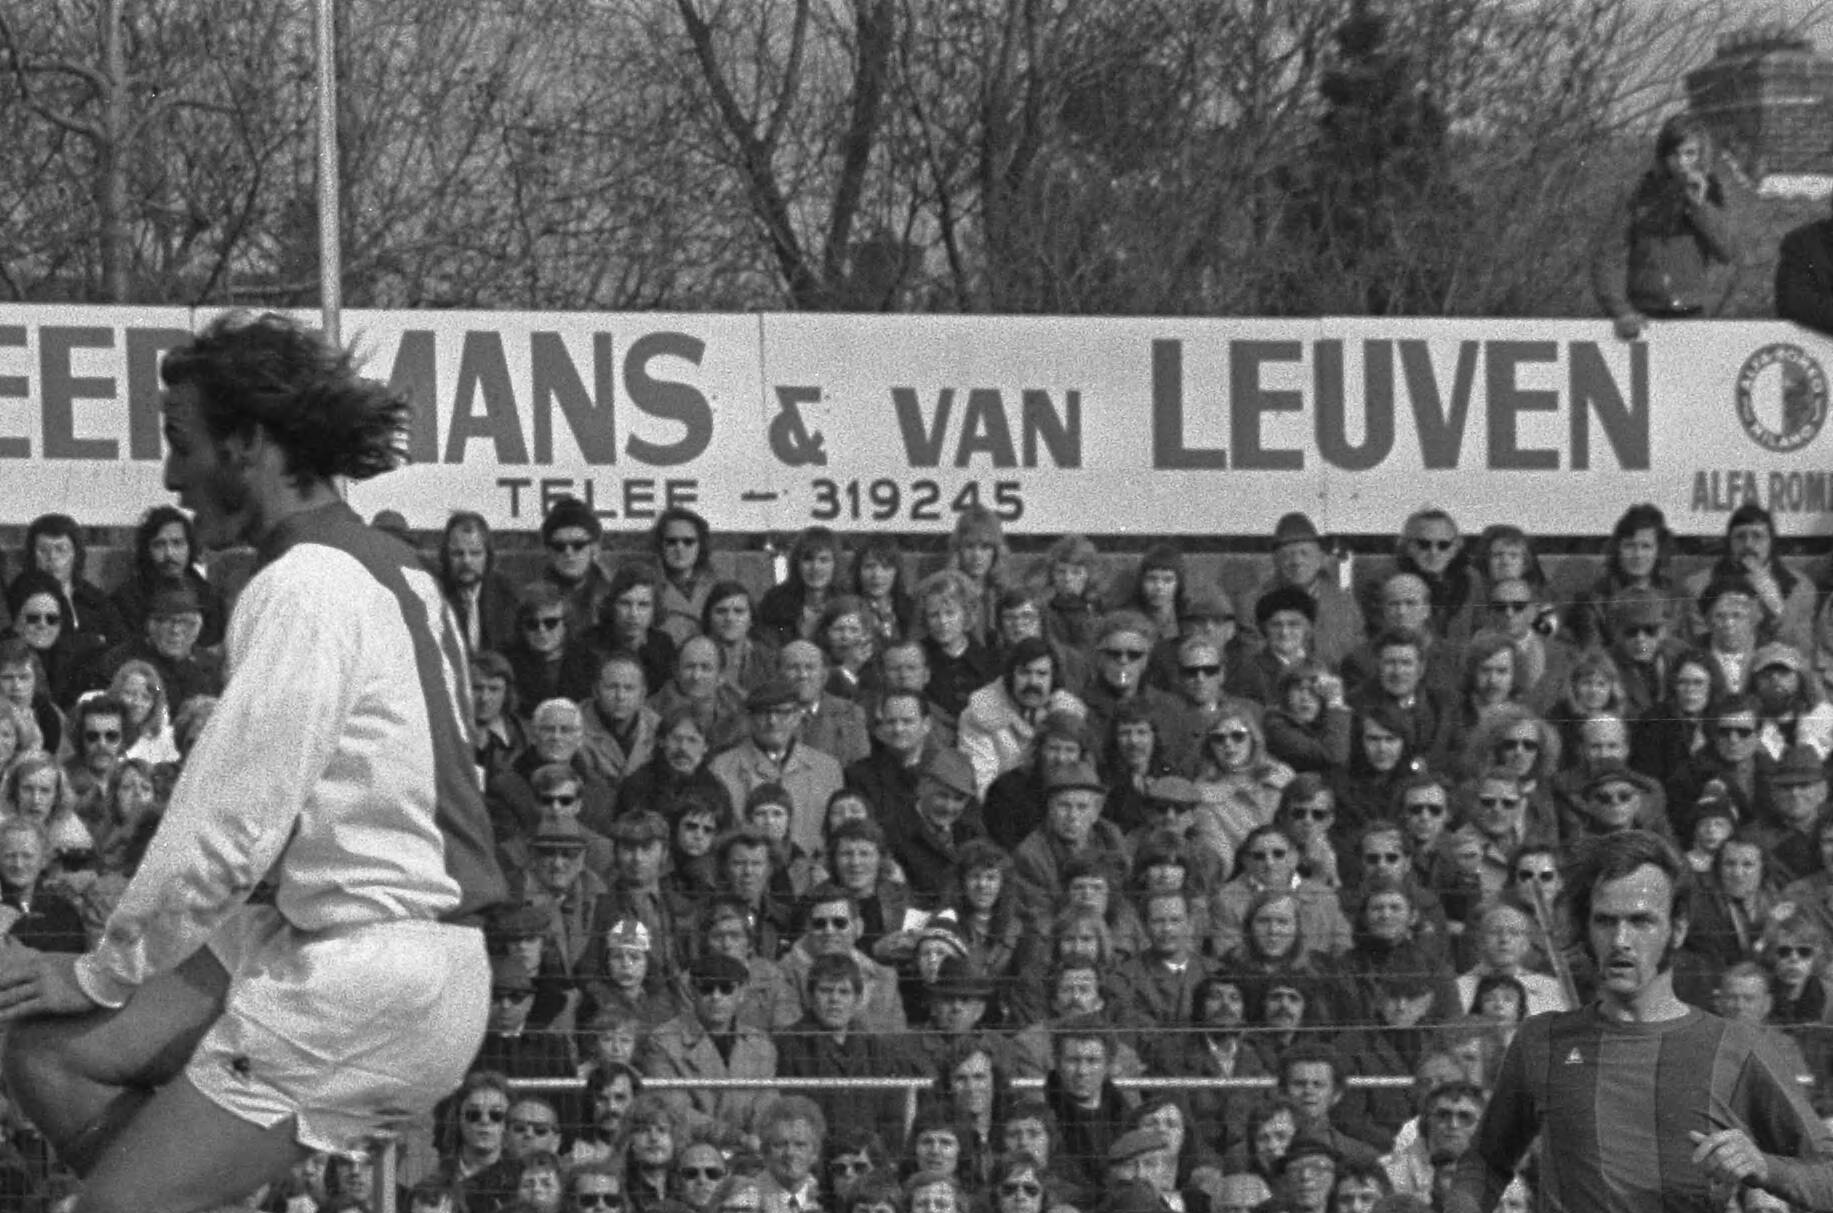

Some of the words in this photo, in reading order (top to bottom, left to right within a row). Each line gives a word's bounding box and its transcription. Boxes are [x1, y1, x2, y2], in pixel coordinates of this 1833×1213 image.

[768, 385, 828, 467] &
[890, 387, 1082, 469] VAN
[1151, 338, 1651, 472] LEUVEN
[811, 478, 1025, 521] 319245
[1691, 470, 1759, 513] ALFA
